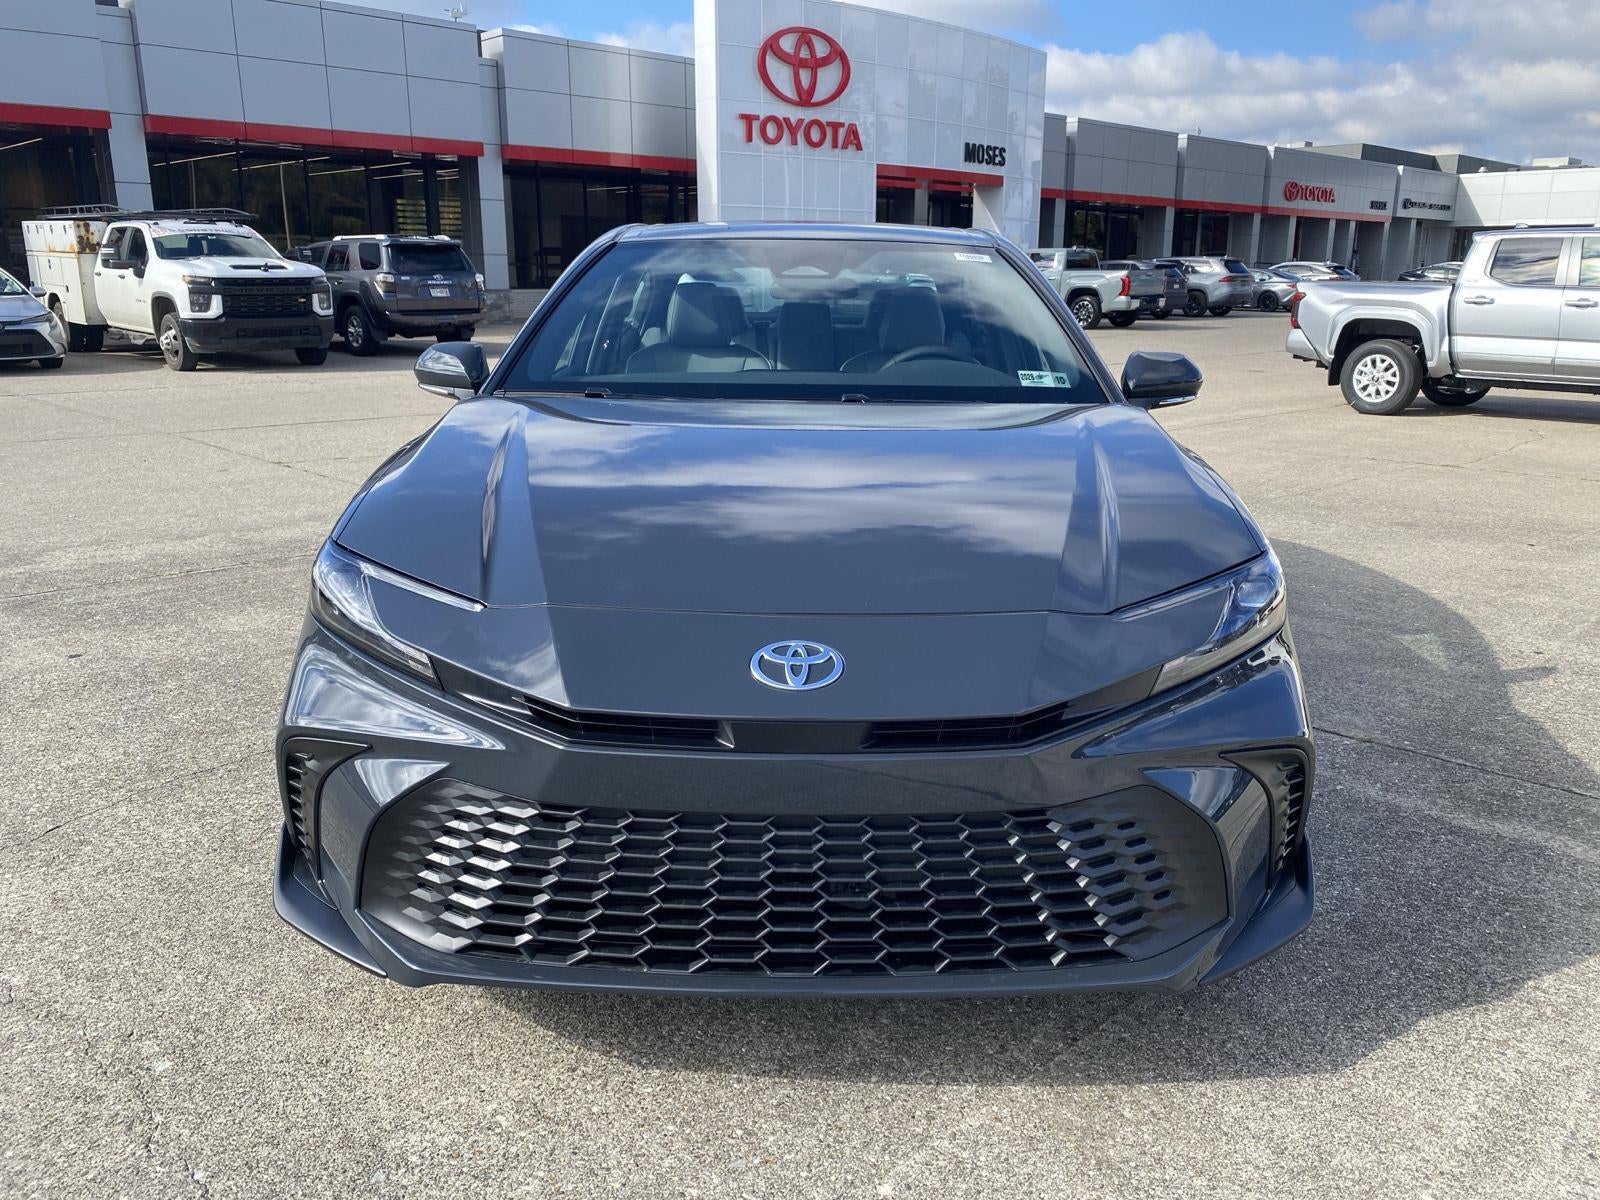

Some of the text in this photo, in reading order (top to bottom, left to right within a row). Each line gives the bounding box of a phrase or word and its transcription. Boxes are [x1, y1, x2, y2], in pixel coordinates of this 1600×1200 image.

[738, 113, 863, 151] TOYOTA
[964, 142, 1006, 167] MOSES
[1300, 185, 1336, 203] TOYOTA
[1055, 376, 1066, 385] 10
